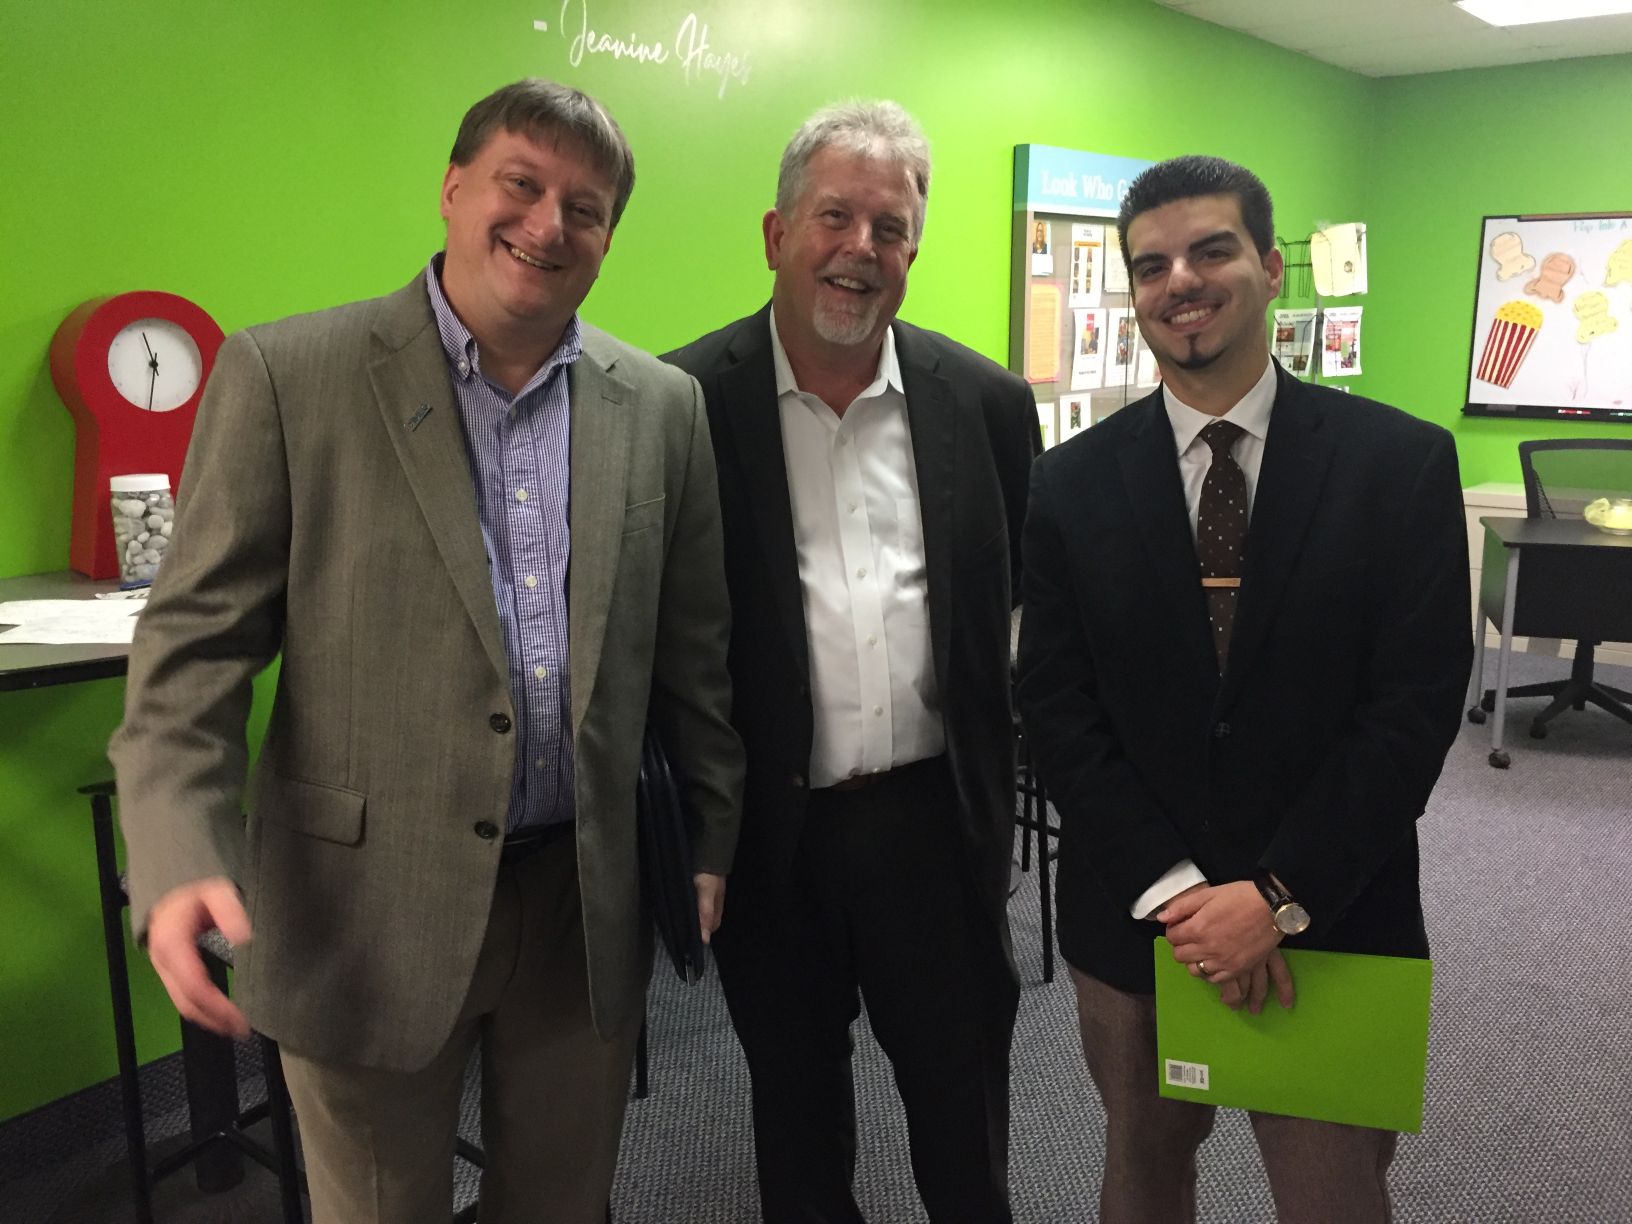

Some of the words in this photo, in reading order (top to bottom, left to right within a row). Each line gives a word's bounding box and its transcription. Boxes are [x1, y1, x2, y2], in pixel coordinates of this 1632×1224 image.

[560, 0, 669, 67] Jeanine
[675, 13, 752, 99] Hayes
[1041, 171, 1078, 197] Look
[1082, 174, 1113, 201] Who
